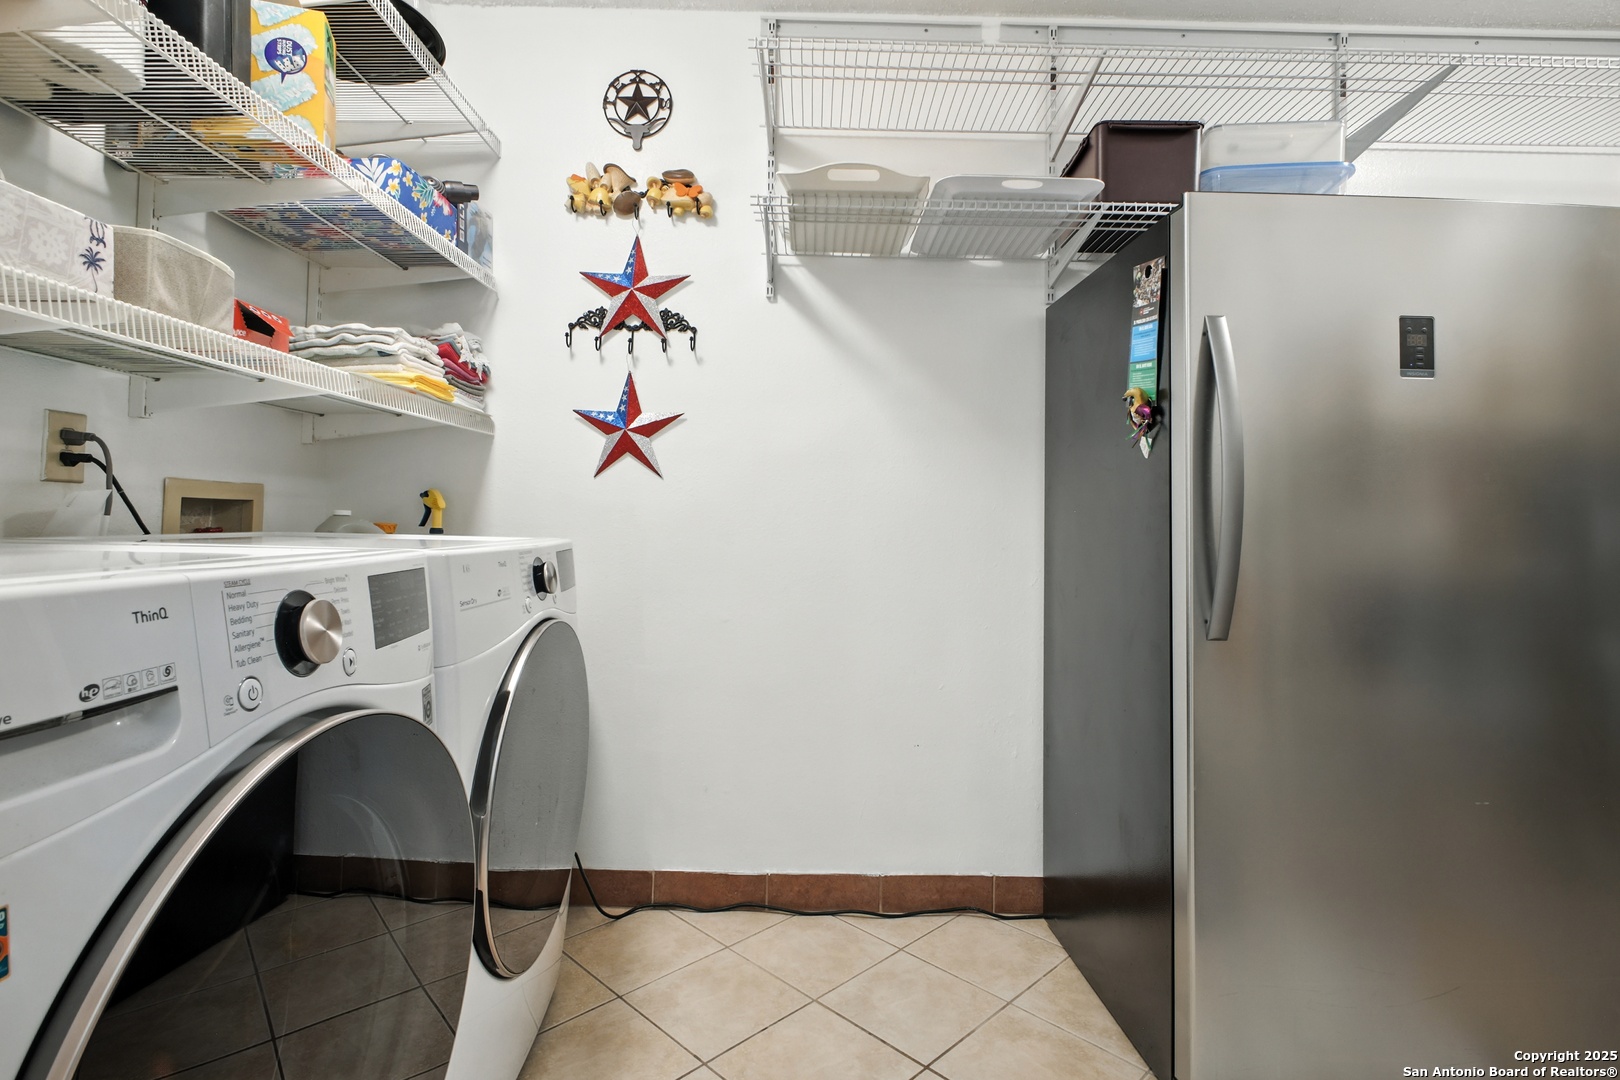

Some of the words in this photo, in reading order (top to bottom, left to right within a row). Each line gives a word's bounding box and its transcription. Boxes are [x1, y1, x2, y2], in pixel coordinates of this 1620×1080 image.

[226, 589, 247, 599] Normal
[227, 603, 245, 612] Heavy
[246, 600, 259, 609] Duty
[132, 606, 169, 624] ThinQ
[230, 615, 253, 626] Bedding
[231, 629, 255, 640] Sanitary
[235, 658, 247, 668] Tub
[247, 655, 263, 665] Clean
